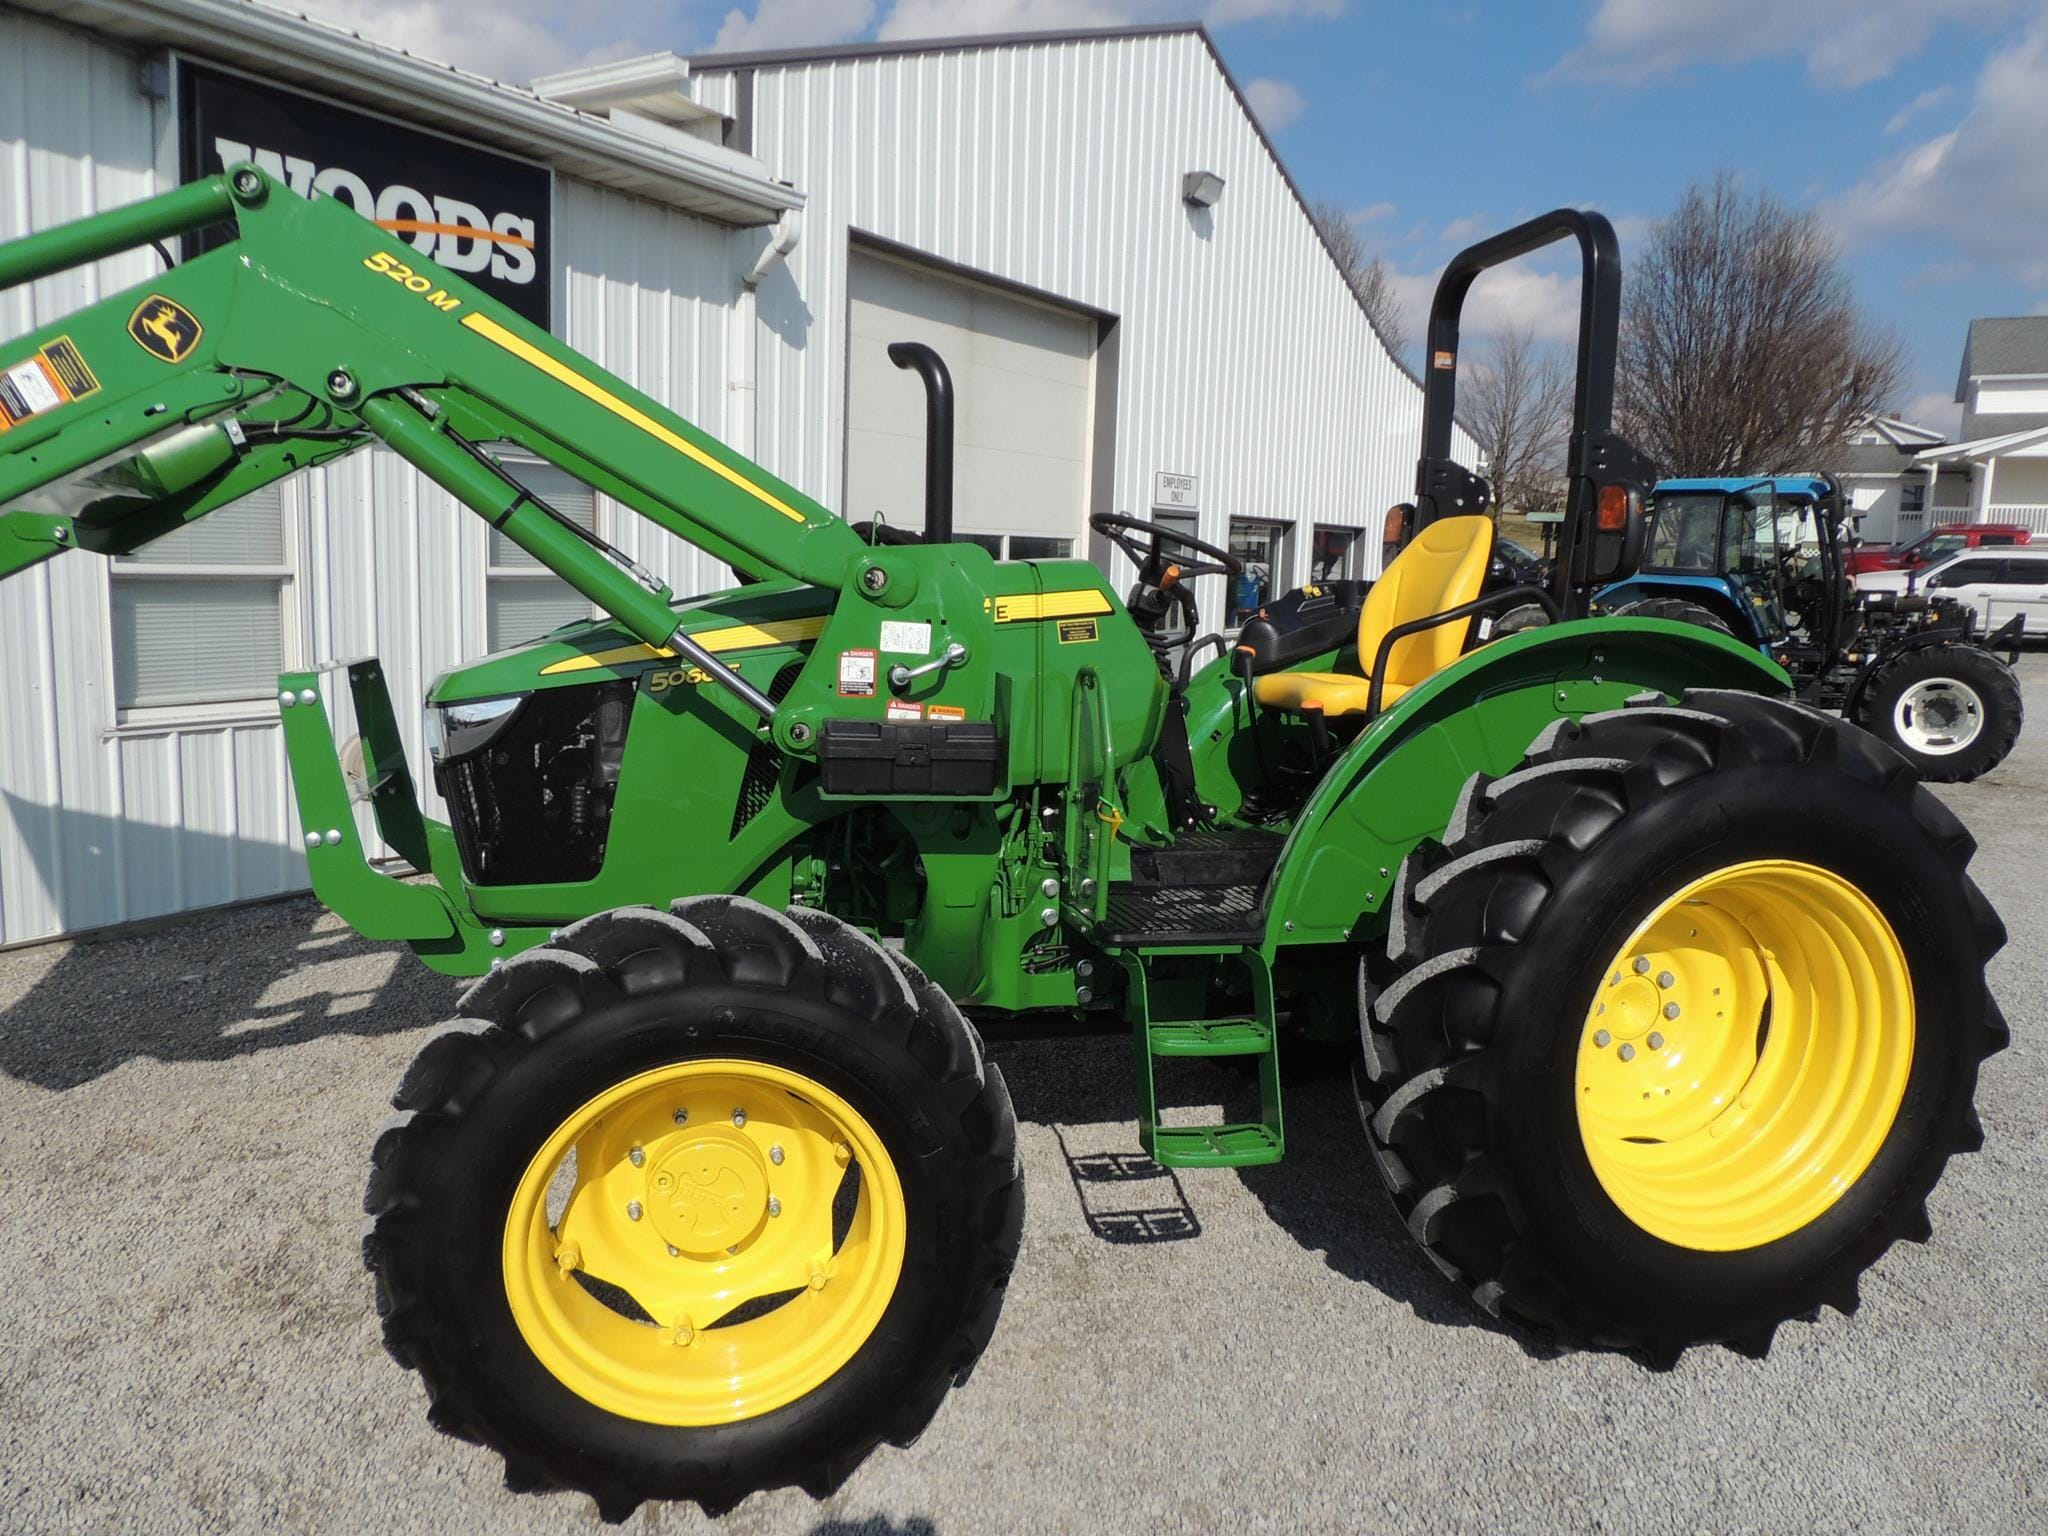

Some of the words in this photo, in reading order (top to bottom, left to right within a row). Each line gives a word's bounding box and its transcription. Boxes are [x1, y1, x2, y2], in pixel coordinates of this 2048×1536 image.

[215, 136, 537, 285] WOODS
[362, 251, 432, 293] 520
[425, 289, 463, 313] M
[1163, 476, 1192, 490] EMPLOYEES
[850, 650, 874, 658] DANGER
[897, 701, 921, 711] DANGER
